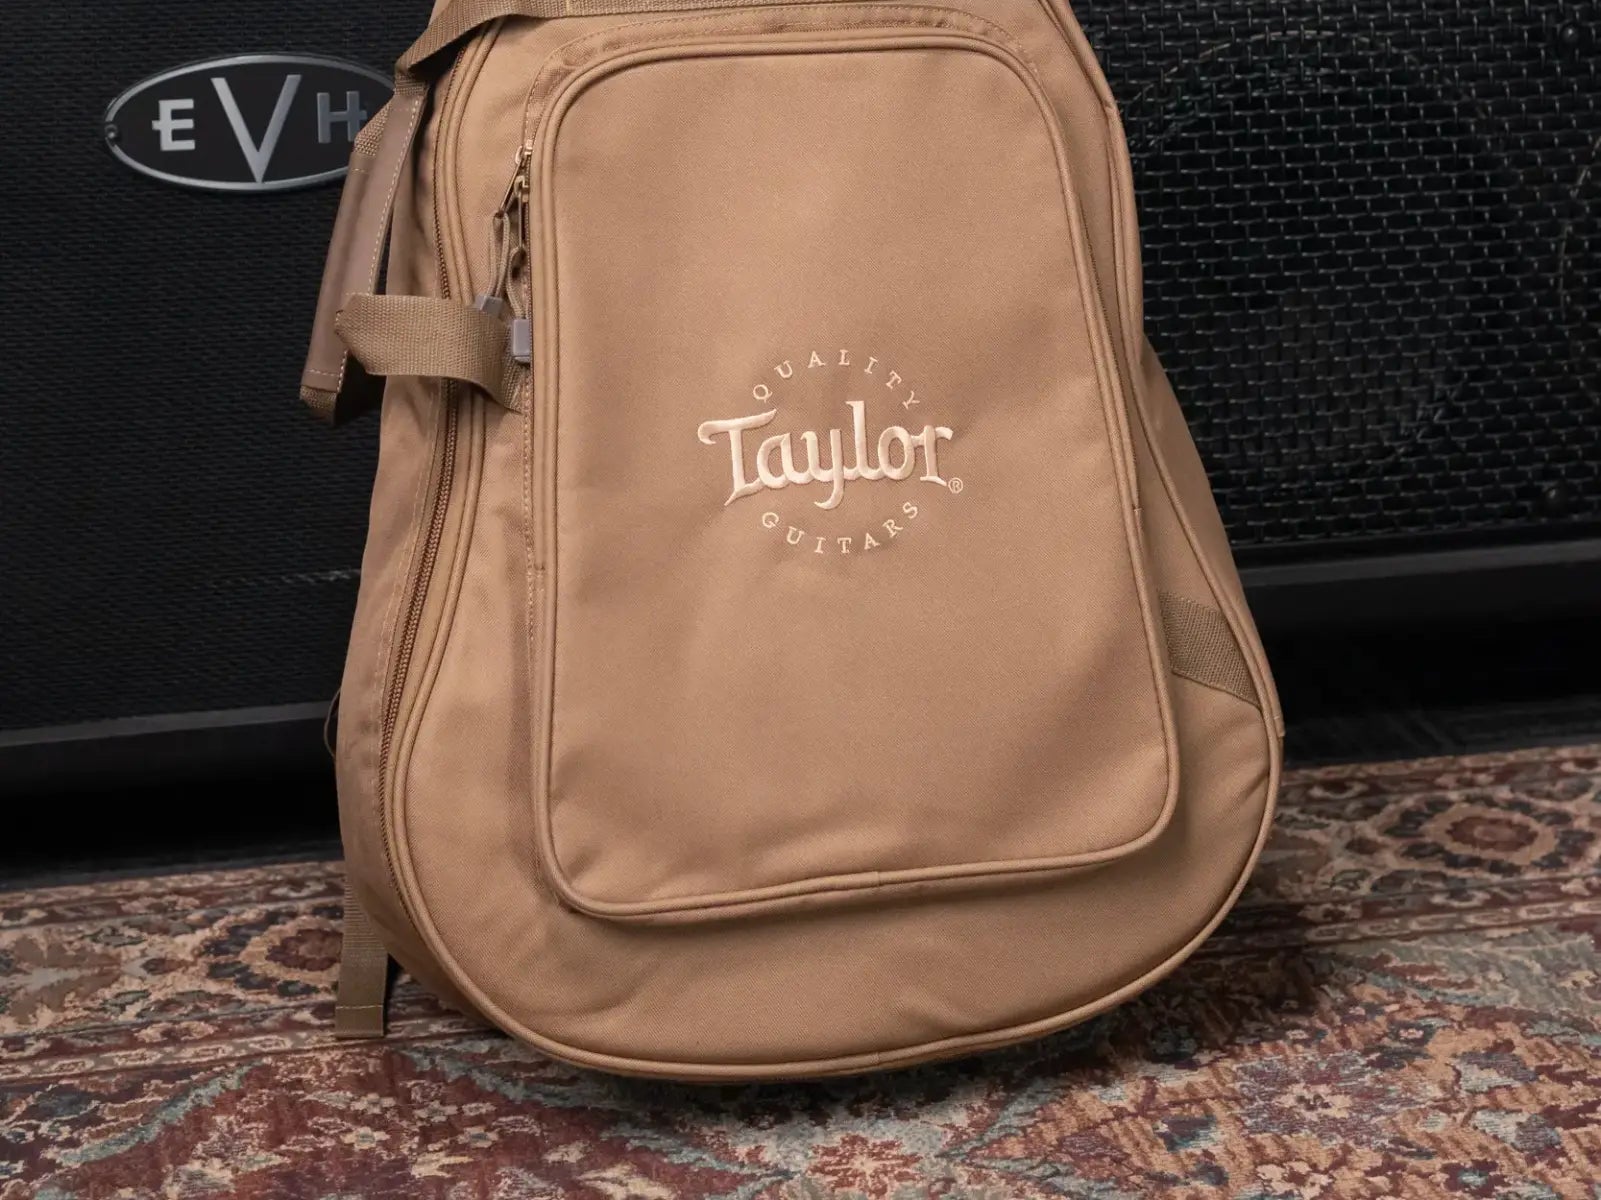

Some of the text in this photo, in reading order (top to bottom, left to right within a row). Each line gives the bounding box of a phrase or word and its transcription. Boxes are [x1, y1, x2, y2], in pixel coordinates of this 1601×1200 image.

[152, 74, 368, 184] EVH
[753, 349, 920, 410] QUALITY
[697, 400, 954, 510] Taylor
[762, 501, 919, 555] GUITARS
